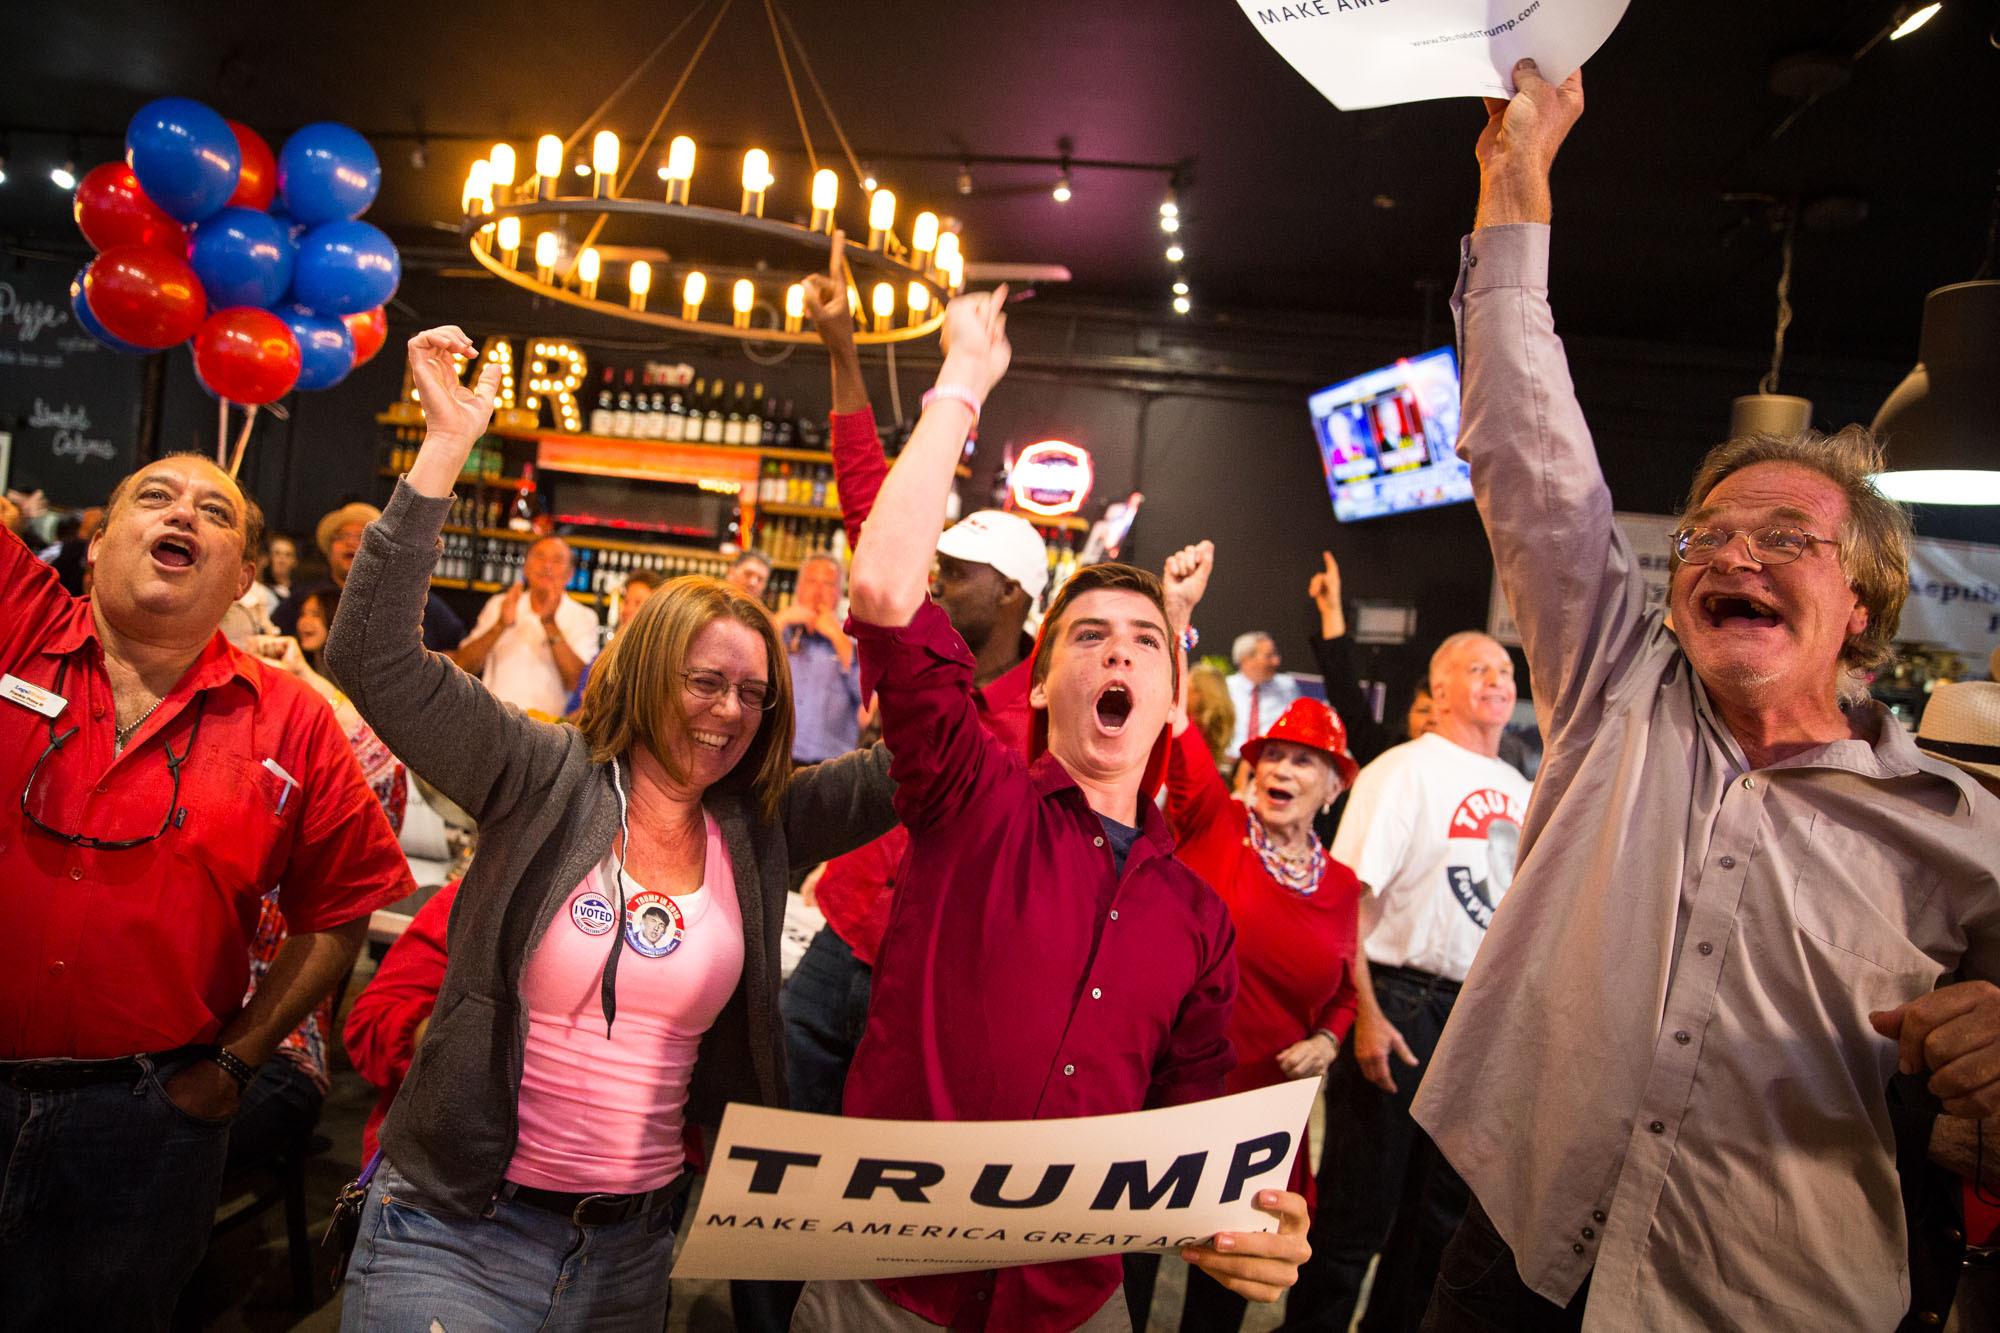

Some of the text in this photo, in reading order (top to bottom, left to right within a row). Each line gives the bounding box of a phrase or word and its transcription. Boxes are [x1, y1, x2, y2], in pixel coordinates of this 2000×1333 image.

[1257, 0, 1330, 25] MAKE
[1454, 790, 1526, 830] TRUM
[580, 906, 612, 922] VOTED
[635, 894, 659, 906] TRUMP
[728, 1131, 1292, 1211] TRUMP
[706, 1213, 820, 1232] MAKE
[832, 1221, 1007, 1241] AMERICA
[1023, 1231, 1142, 1246] GREAT
